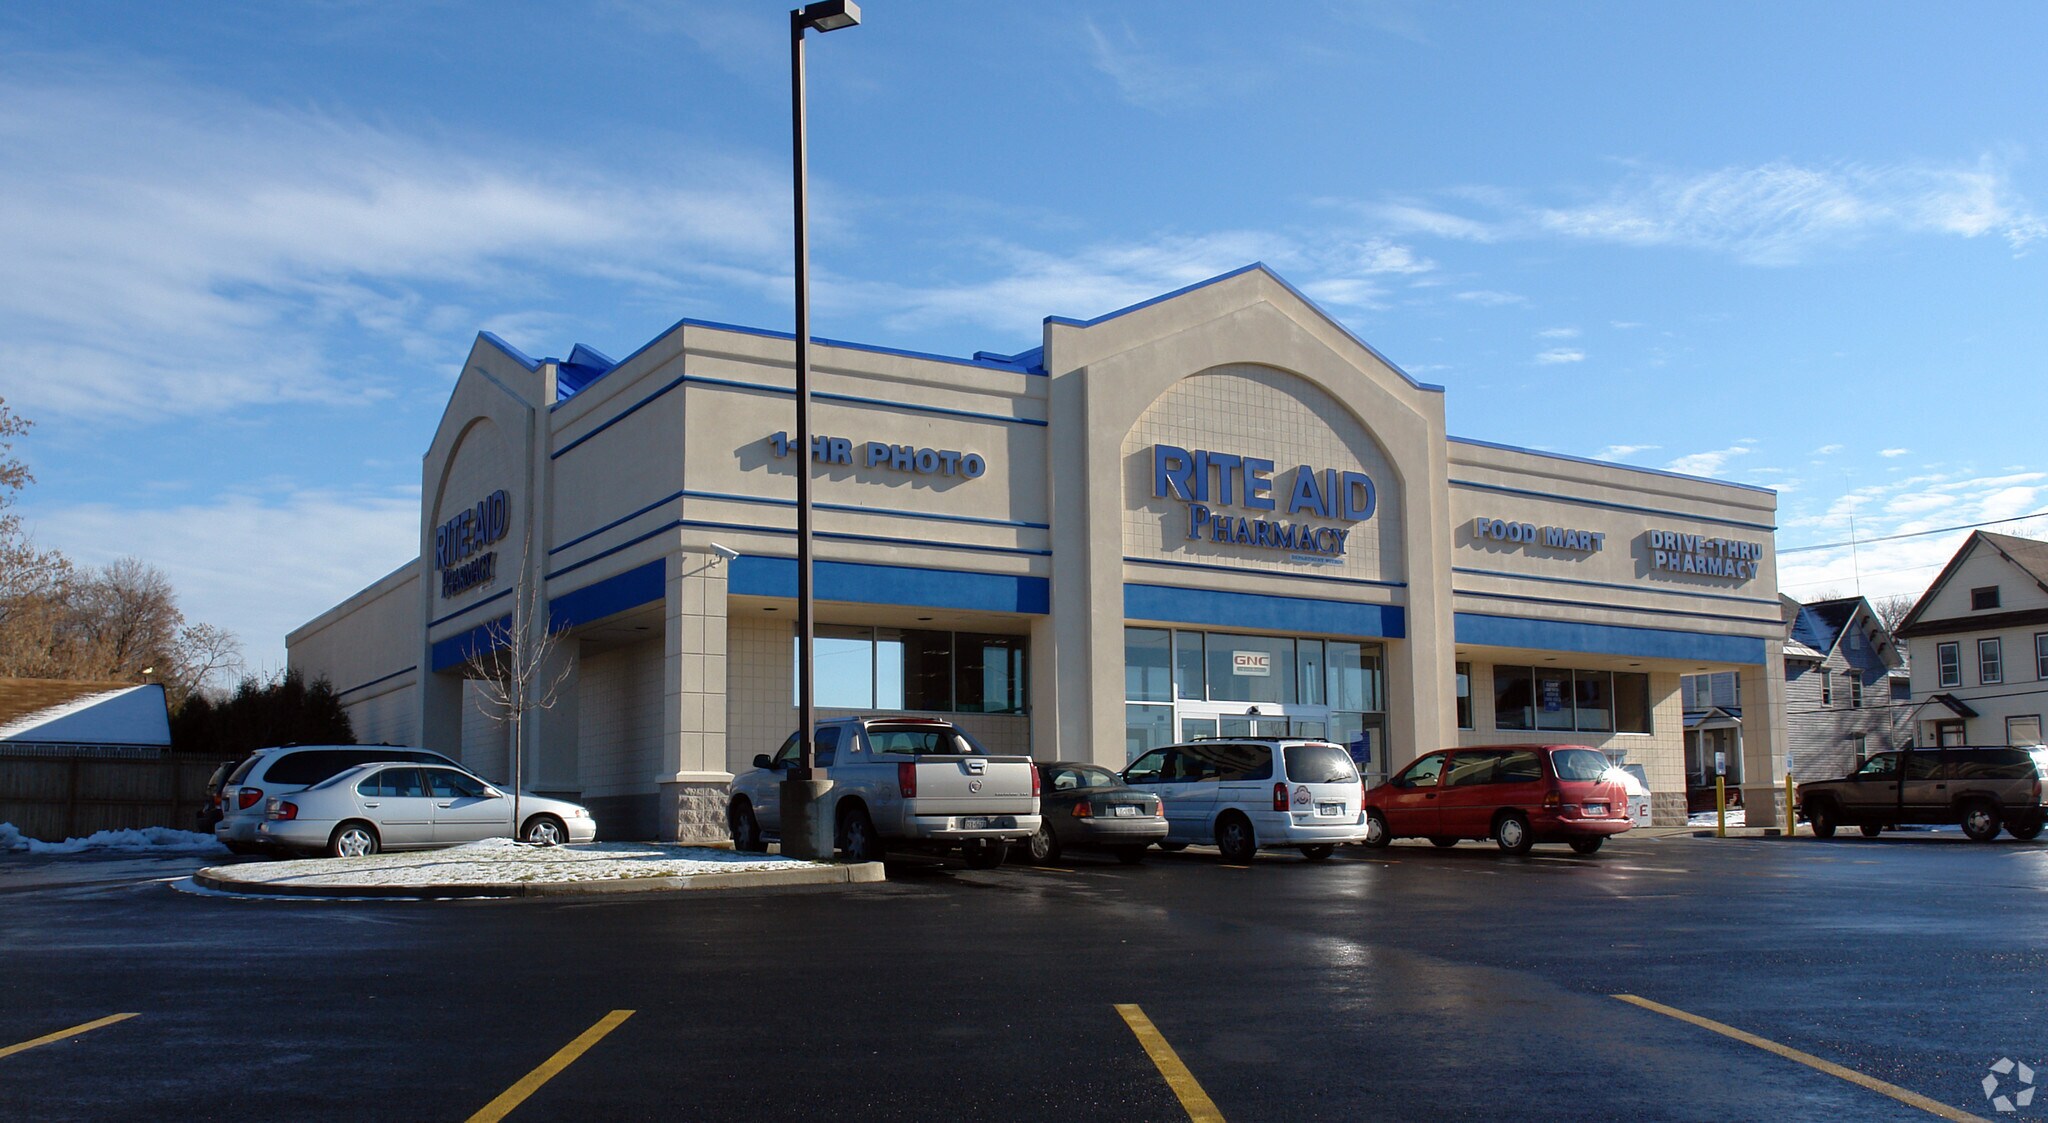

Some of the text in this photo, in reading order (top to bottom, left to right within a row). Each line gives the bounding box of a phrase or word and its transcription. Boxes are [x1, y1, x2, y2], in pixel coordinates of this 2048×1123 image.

[769, 431, 986, 479] 1-HR PHOTO
[1153, 443, 1377, 521] RITE AID
[435, 490, 508, 571] RITE AID
[1186, 503, 1349, 555] PHARMACY
[1474, 517, 1606, 551] FOOD MART
[1650, 529, 1763, 561] DRIVE-THRU
[1654, 550, 1759, 580] PHARMACY
[1234, 655, 1269, 666] GNC
